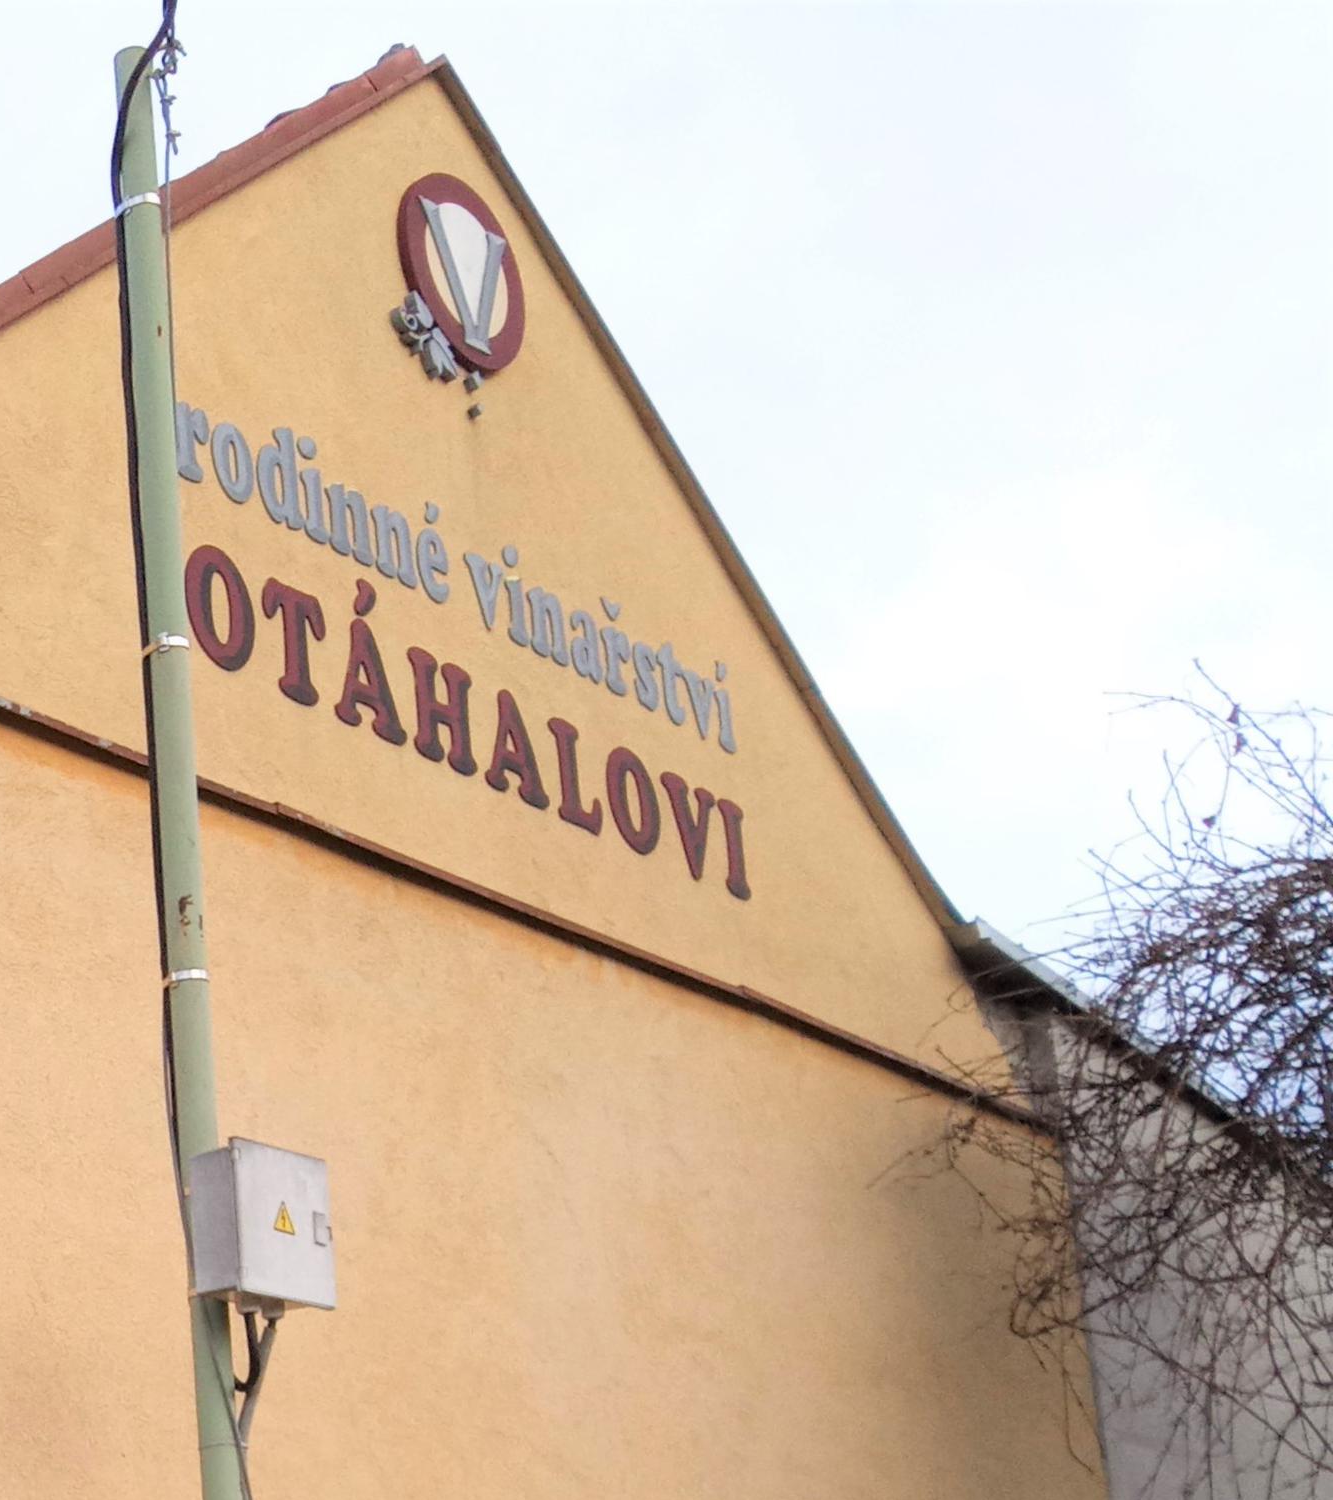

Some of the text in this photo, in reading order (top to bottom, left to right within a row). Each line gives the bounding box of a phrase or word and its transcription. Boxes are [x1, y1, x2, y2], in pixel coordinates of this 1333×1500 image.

[174, 401, 738, 755] rodinné vinařství
[184, 544, 752, 901] OTÁHALOVI
